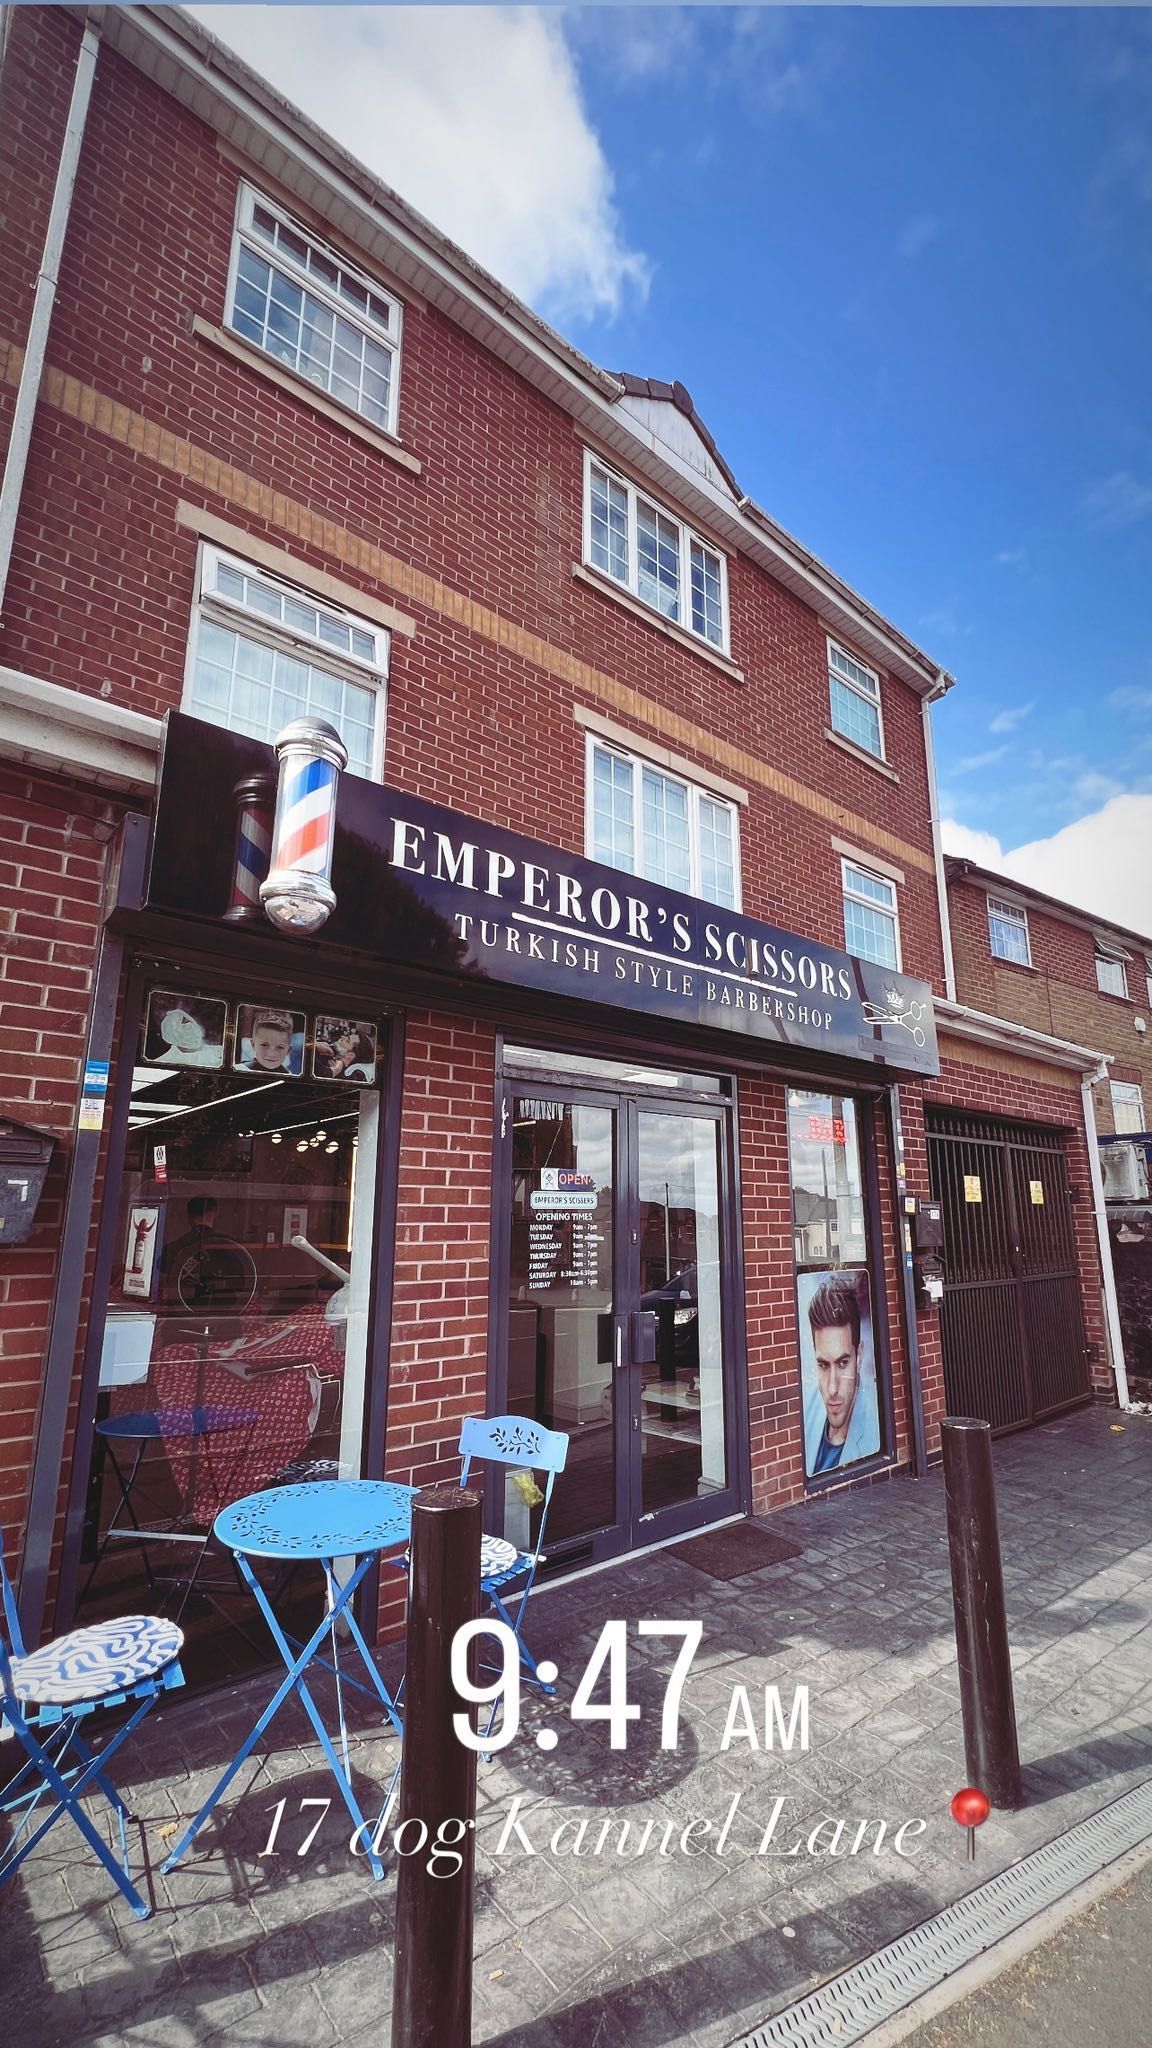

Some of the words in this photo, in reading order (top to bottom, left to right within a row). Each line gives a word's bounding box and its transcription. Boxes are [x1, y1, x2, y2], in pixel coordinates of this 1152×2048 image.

[388, 817, 692, 952] EMPEROR'S
[704, 924, 852, 1001] SCISSORS
[454, 913, 600, 973] TURKISH
[615, 956, 694, 997] STYLE
[706, 980, 833, 1030] BARBERSHOP
[558, 1173, 588, 1185] OPEN
[535, 1212, 571, 1221] OPENING
[571, 1212, 593, 1221] TIMES
[530, 1233, 554, 1241] TUESDAY
[530, 1242, 562, 1250] WEDNESDAY
[530, 1252, 557, 1260] THURSDAY
[529, 1262, 549, 1270] FRIDAY
[529, 1271, 557, 1280] SATURDAY
[529, 1281, 551, 1290] SUNDAY
